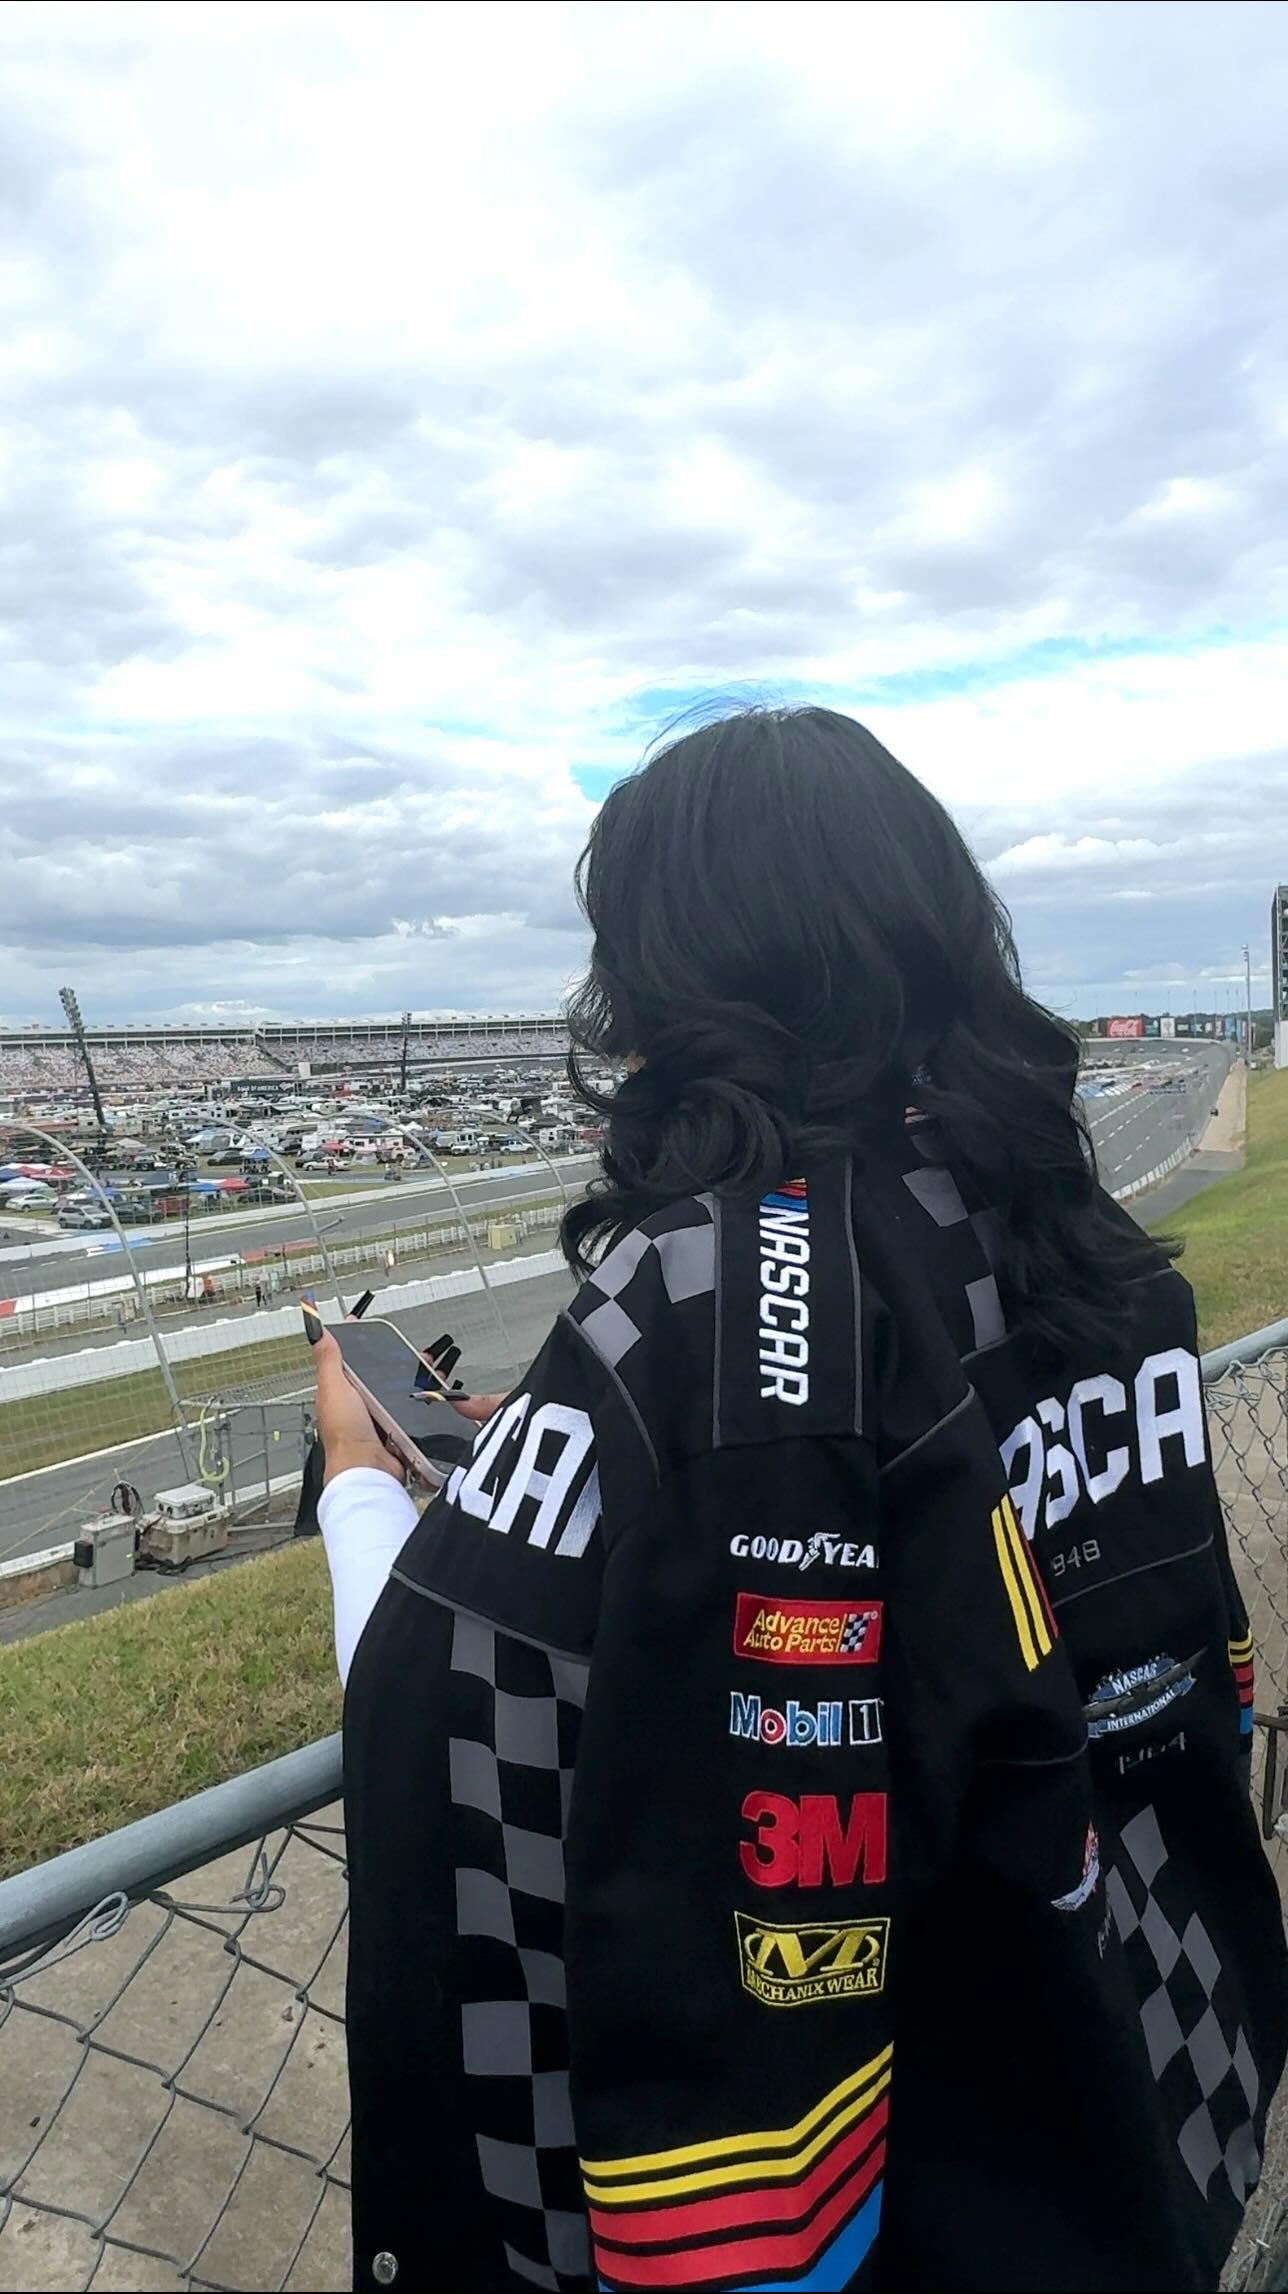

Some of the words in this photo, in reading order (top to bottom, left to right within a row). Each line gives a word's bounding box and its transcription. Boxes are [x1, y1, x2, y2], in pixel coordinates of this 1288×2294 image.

[758, 1204, 811, 1407] NASCAR
[729, 1533, 880, 1570] GOODYEA
[743, 1630, 784, 1651] Auto
[785, 1633, 836, 1653] Parts
[752, 1609, 840, 1635] Advance
[729, 1690, 843, 1747] Mobil
[1106, 1688, 1177, 1730] INTERNATIONAL
[739, 1790, 888, 1888] 3M
[745, 1963, 825, 2001] MECHANIX
[827, 1967, 879, 1993] WEAR
